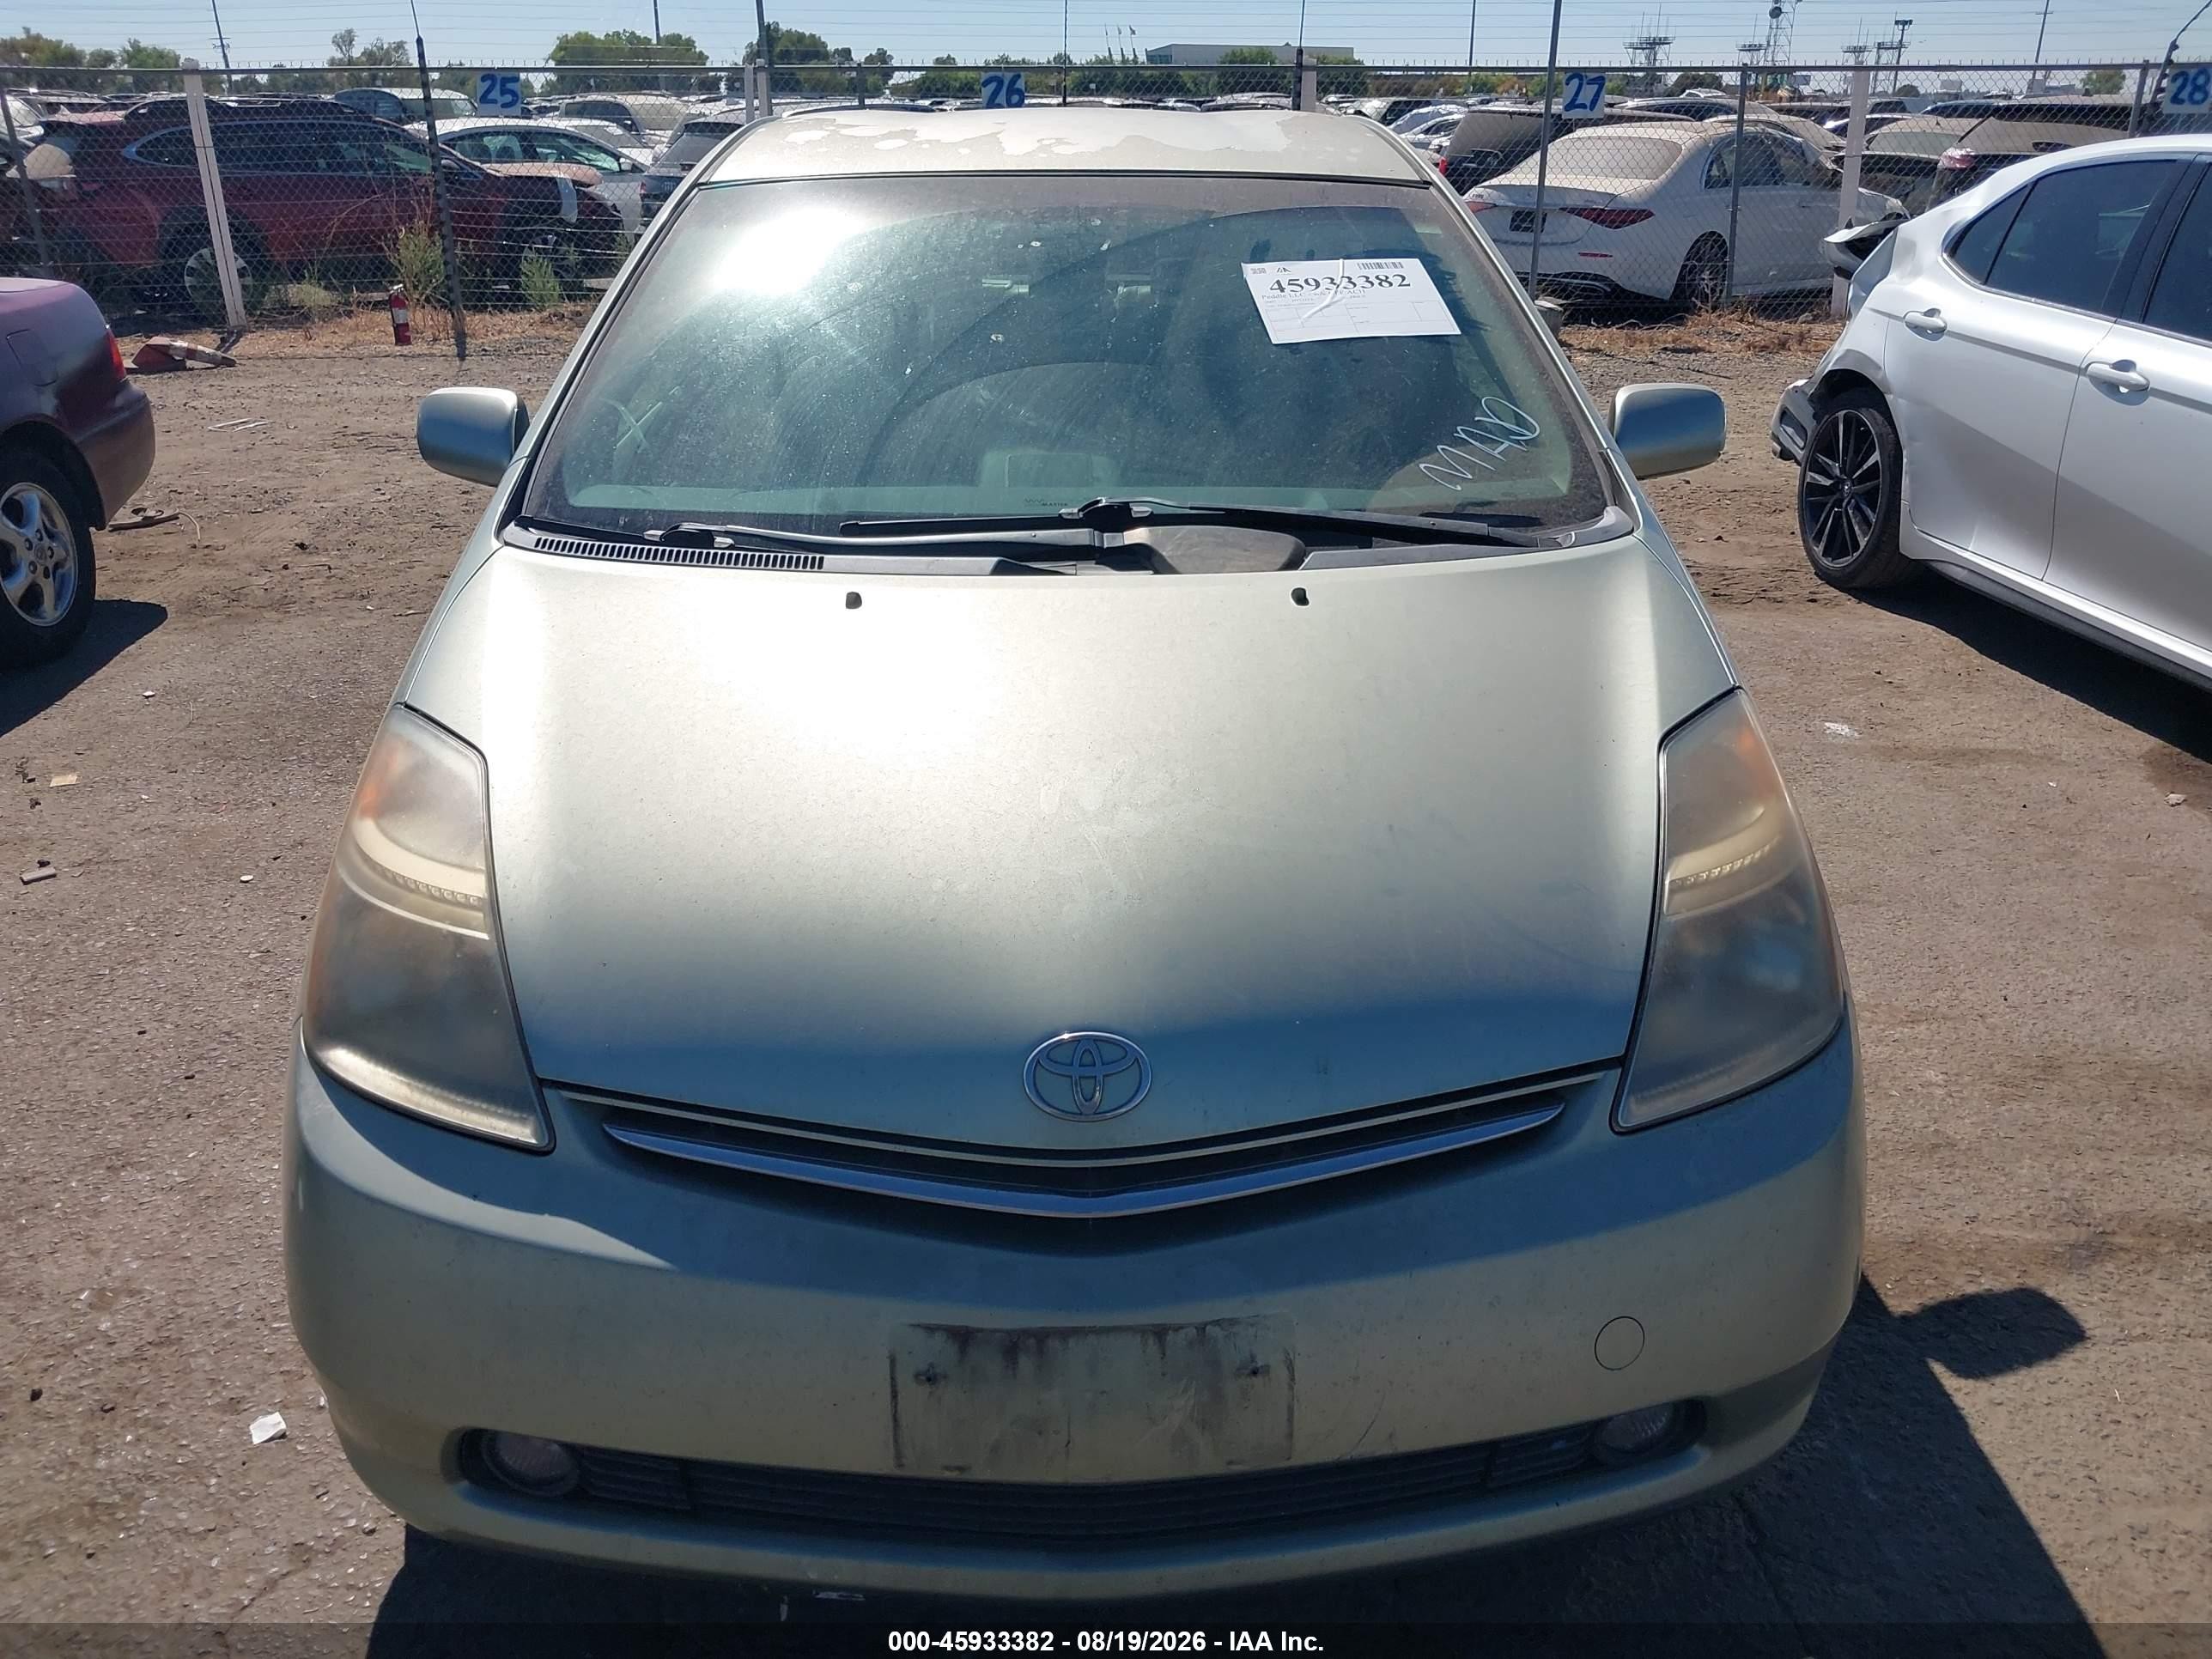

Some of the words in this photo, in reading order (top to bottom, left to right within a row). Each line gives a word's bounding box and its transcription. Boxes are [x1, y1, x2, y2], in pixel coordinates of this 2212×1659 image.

[480, 74, 520, 108] 25
[981, 74, 1025, 109] 26
[1565, 73, 1606, 112] 27
[2170, 68, 2210, 105] 28
[1269, 273, 1411, 294] 45933382
